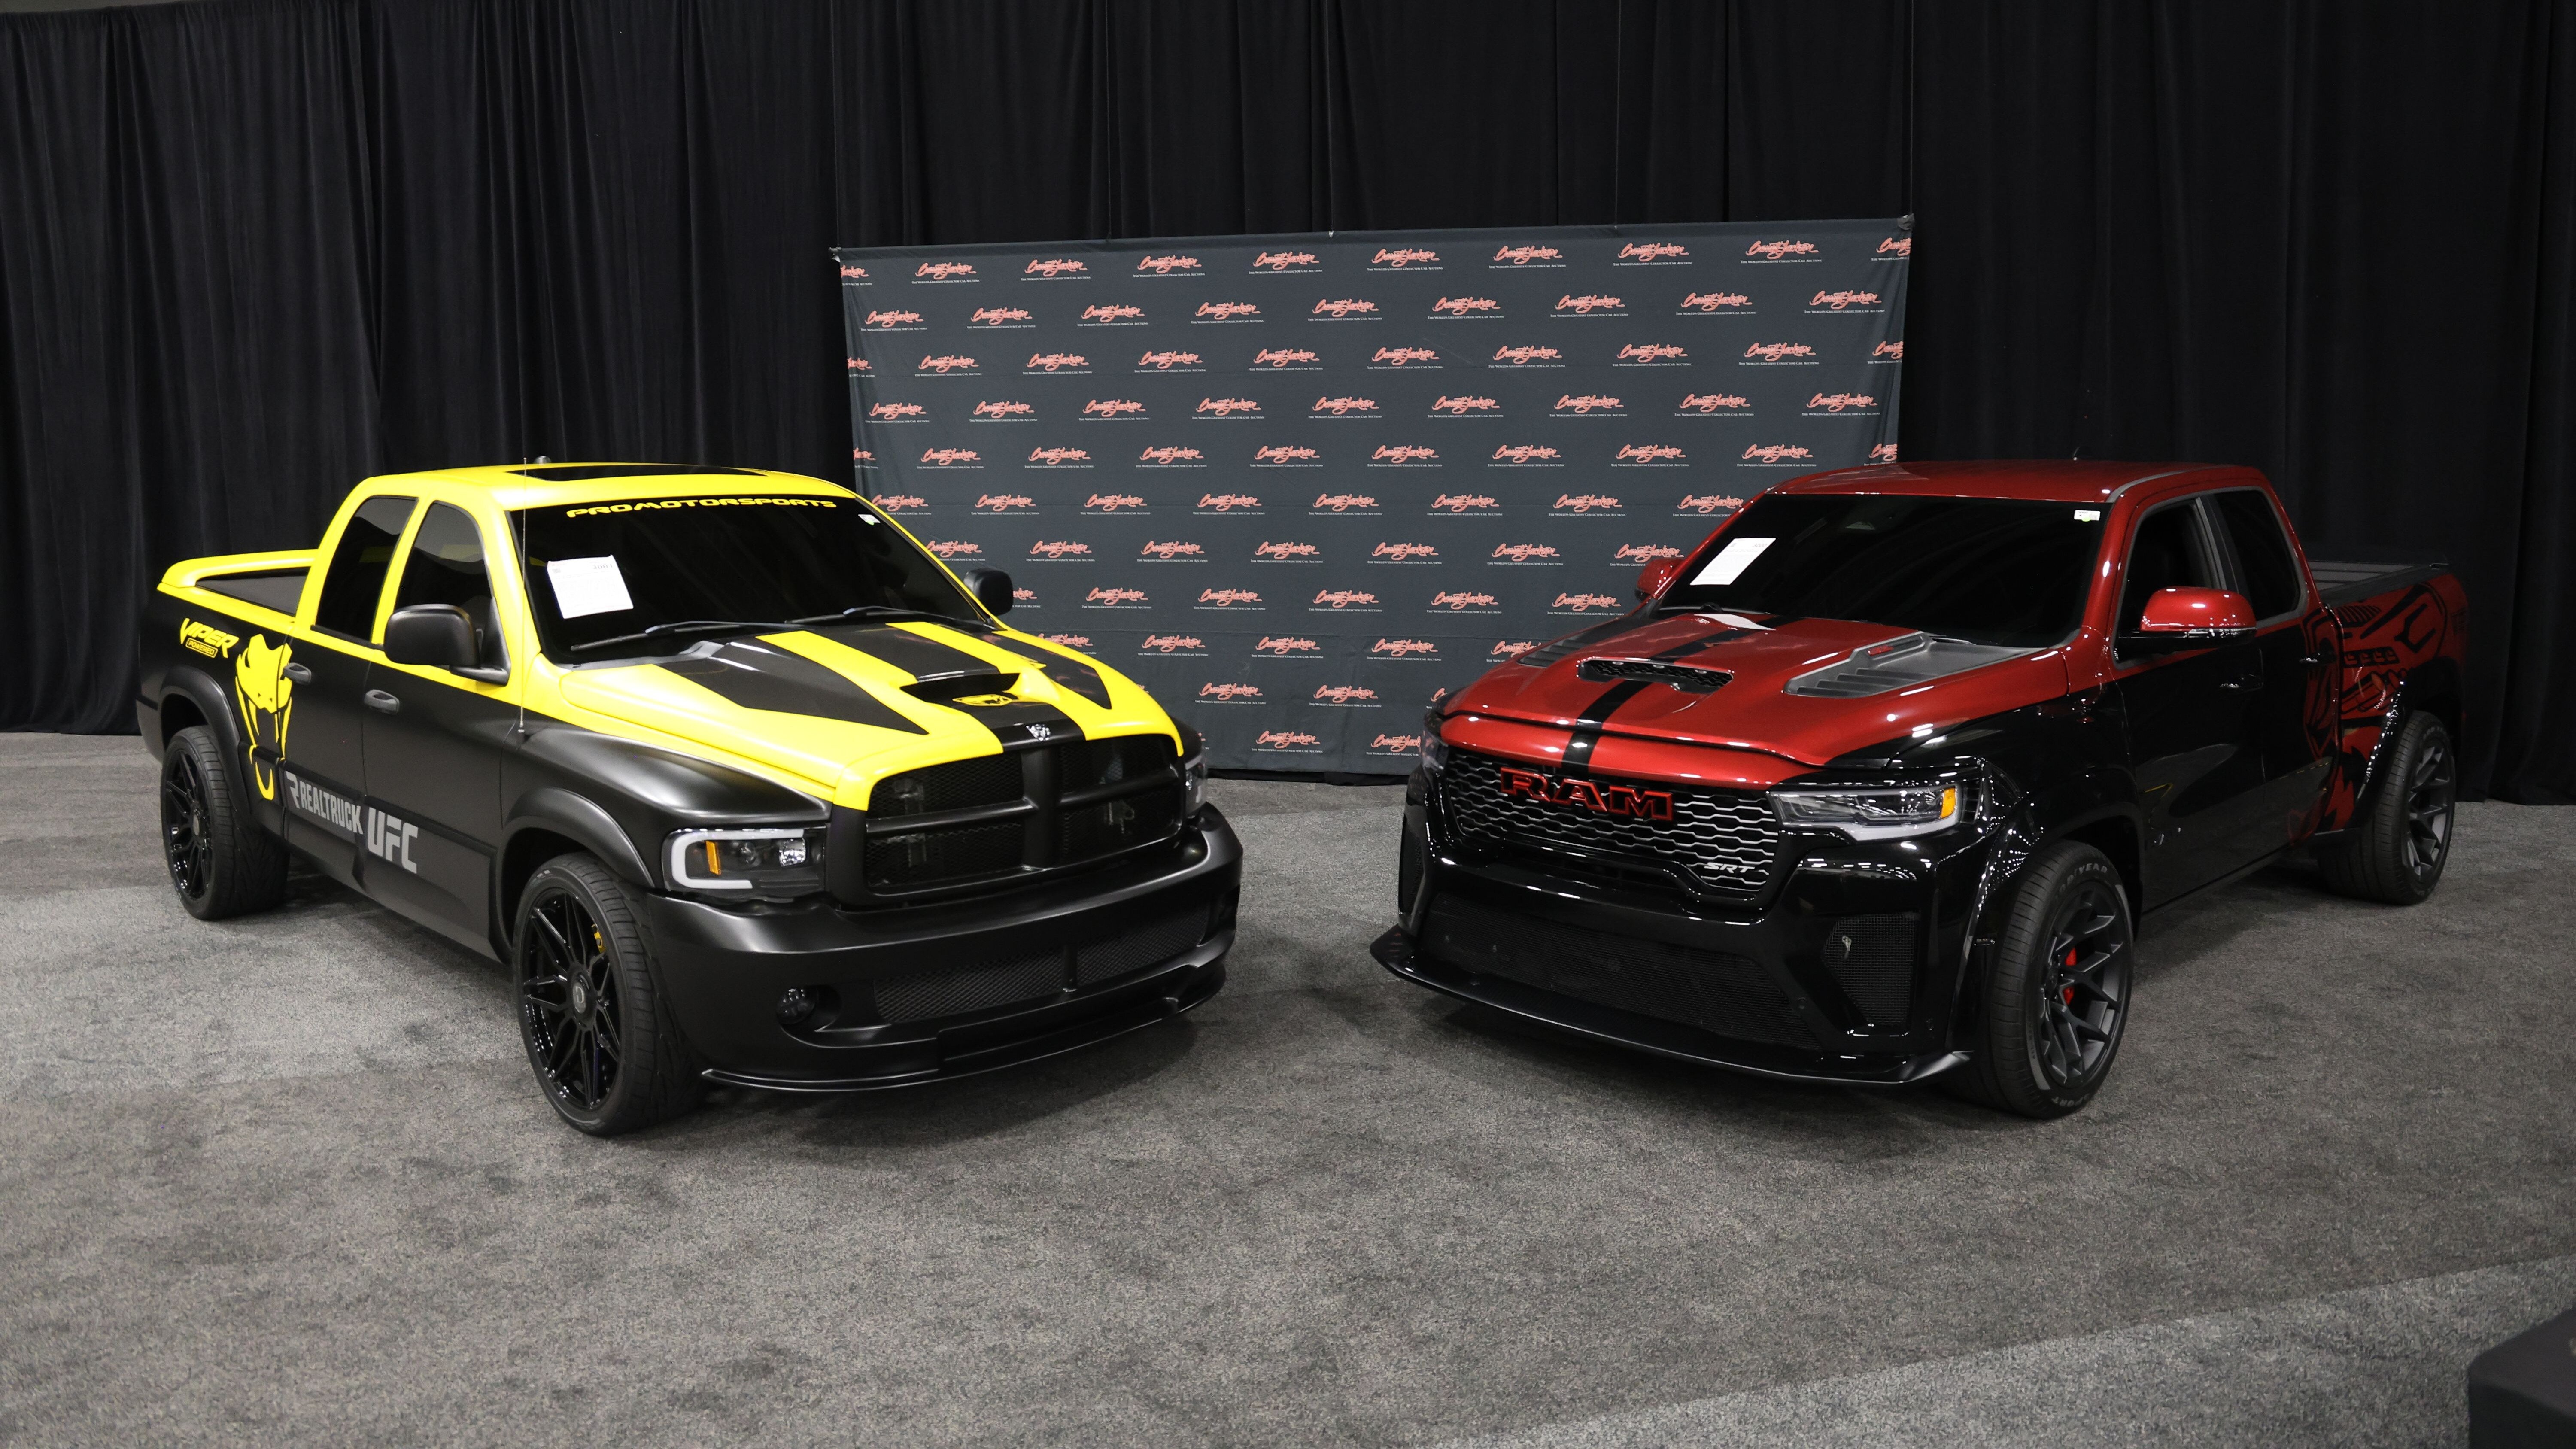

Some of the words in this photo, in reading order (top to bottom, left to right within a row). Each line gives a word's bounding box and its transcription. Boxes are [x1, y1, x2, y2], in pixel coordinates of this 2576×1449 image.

[566, 498, 837, 517] PROMOTORSPORTS
[180, 618, 239, 658] VIPER
[188, 640, 215, 655] POWERED
[300, 781, 364, 834] REALTRUCK
[1501, 767, 1674, 821] RAM
[368, 807, 419, 874] UFC
[1704, 862, 1756, 873] SRT
